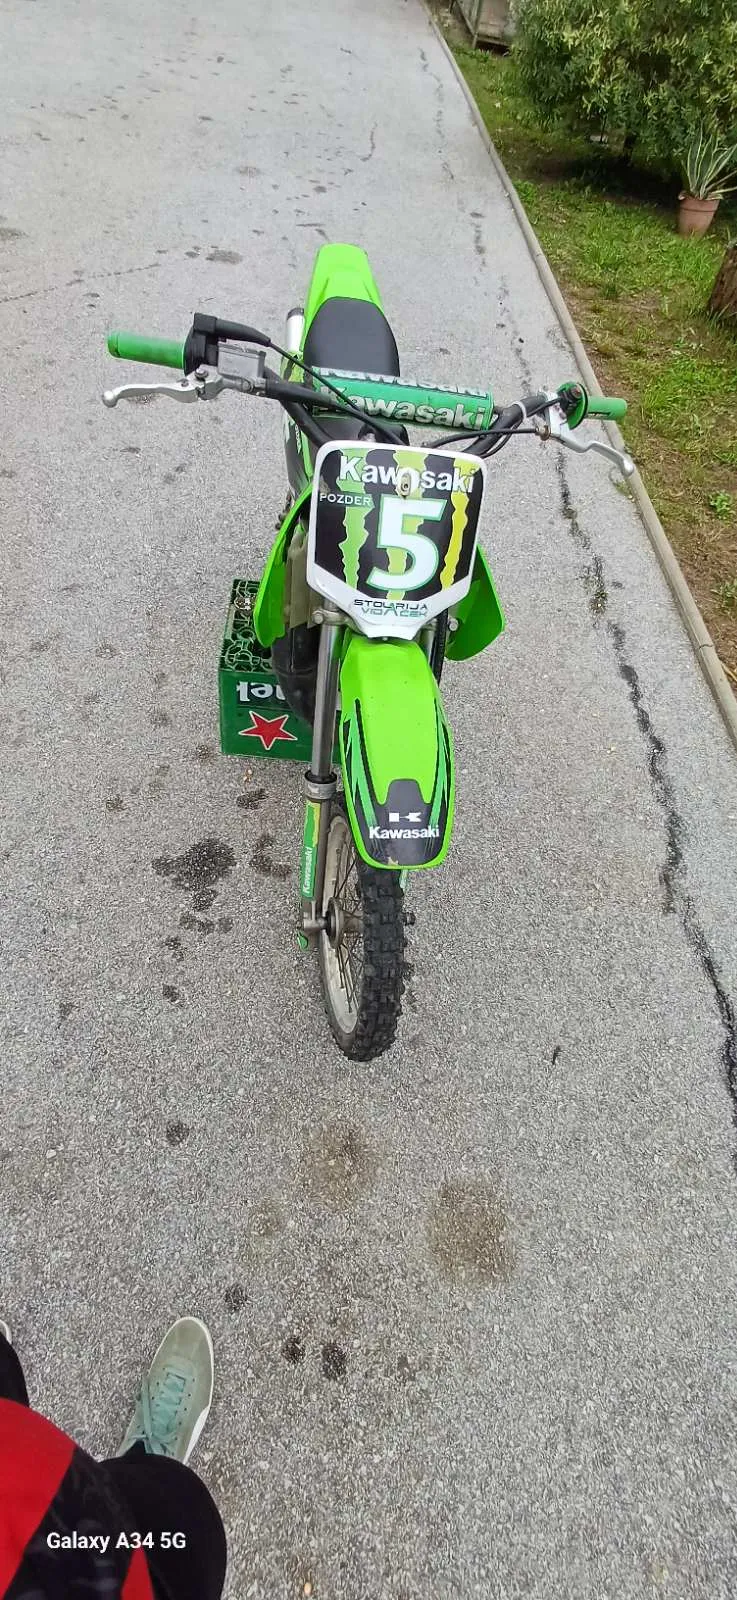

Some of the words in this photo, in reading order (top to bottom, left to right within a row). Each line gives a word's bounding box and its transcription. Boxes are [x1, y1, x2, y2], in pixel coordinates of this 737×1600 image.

[319, 493, 372, 506] POZDER
[366, 494, 447, 591] 5
[354, 599, 428, 610] STOLARIJA
[369, 825, 440, 839] Kawasaki
[302, 846, 313, 894] Kawasaki
